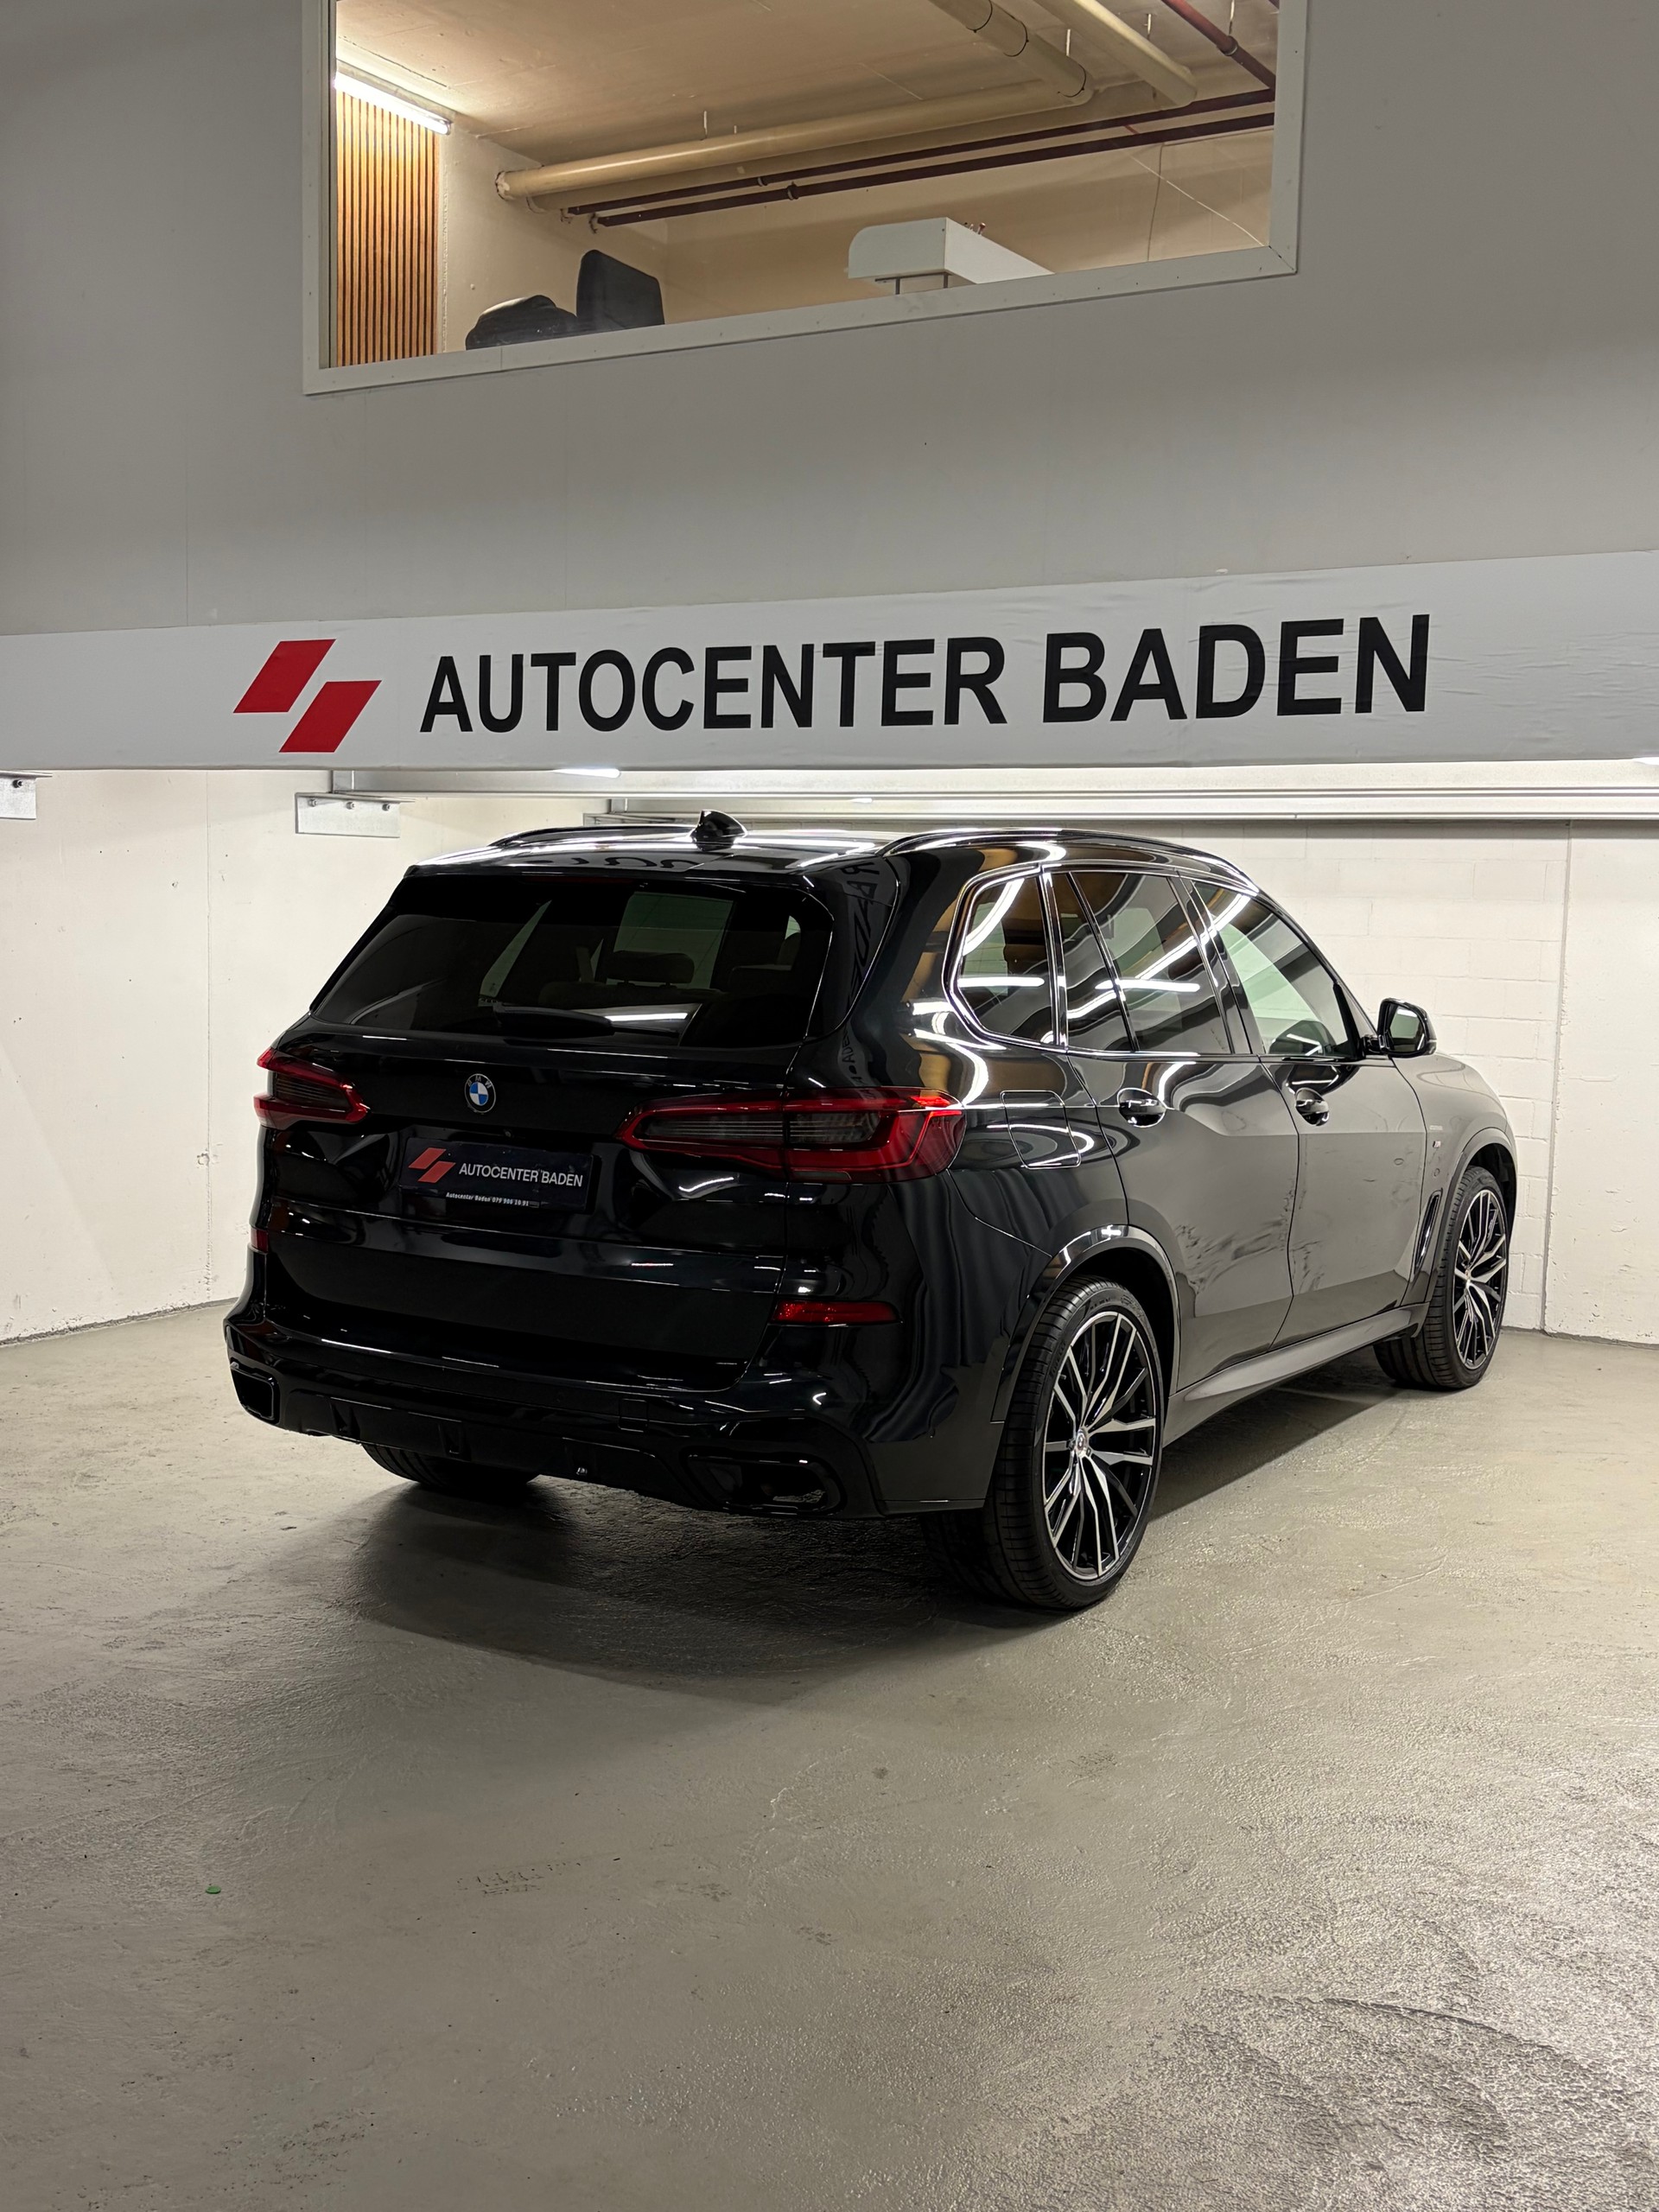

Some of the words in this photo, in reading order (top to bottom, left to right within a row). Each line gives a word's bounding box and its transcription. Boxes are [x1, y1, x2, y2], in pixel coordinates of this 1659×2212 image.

[420, 637, 1008, 734] AUTOCENTER
[1042, 613, 1430, 723] BADEN
[467, 1074, 493, 1089] BMW
[459, 1163, 538, 1183] AUTOCENTER
[541, 1171, 583, 1187] BADEN
